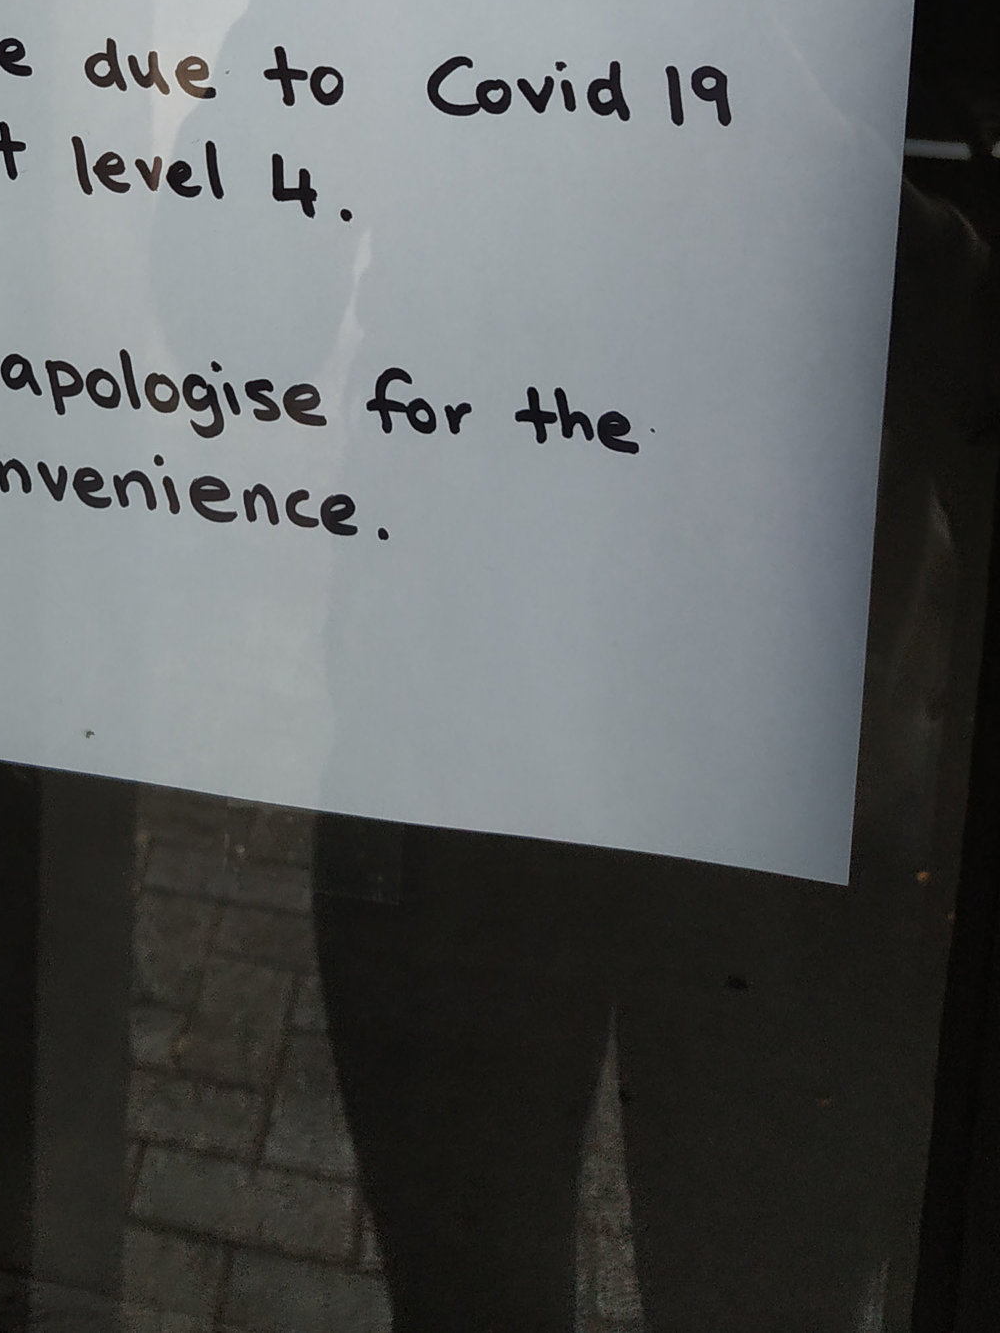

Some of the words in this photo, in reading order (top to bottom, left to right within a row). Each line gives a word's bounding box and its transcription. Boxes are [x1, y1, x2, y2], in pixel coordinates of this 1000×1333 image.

[84, 37, 217, 100] due
[263, 45, 344, 107] to
[426, 55, 631, 122] Covid
[667, 65, 732, 127] 19
[70, 135, 225, 200] level
[271, 153, 353, 223] 4.
[0, 348, 328, 439] apologise
[365, 367, 473, 435] for
[514, 386, 640, 455] the
